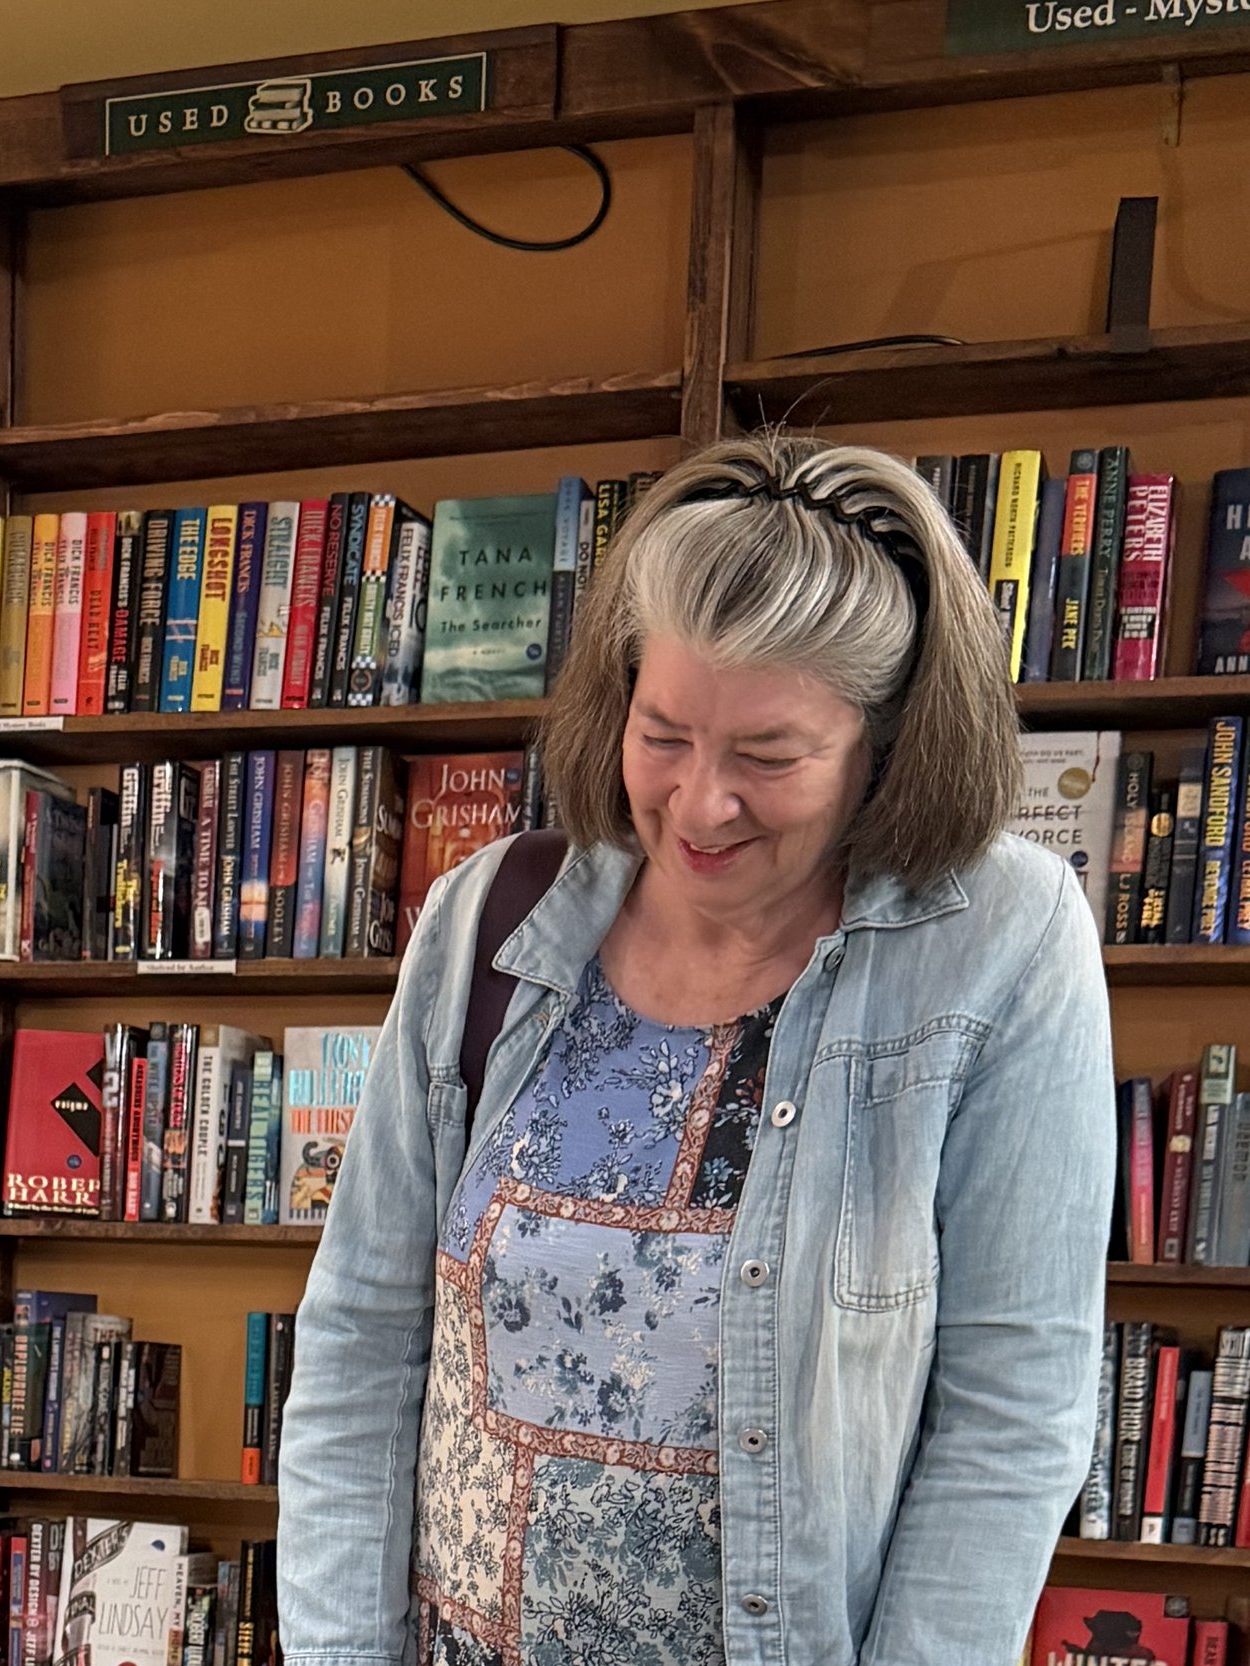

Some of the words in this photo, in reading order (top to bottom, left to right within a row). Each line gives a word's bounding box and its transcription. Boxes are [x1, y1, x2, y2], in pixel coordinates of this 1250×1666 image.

[1025, 1, 1116, 33] Used
[128, 104, 229, 137] USED
[325, 76, 464, 114] BOOKS
[179, 518, 200, 543] THE
[301, 509, 325, 542] DICK
[329, 503, 343, 530] NO
[1100, 505, 1116, 560] PERRY
[1124, 486, 1148, 562] PETERS
[1143, 485, 1168, 562] ELIZABETH
[143, 519, 169, 578] DRIVING
[177, 546, 198, 581] EDGE
[205, 517, 233, 602] LONGSHOT
[265, 516, 292, 588] STRAIGHT
[322, 532, 341, 597] RESERVE
[344, 503, 365, 587] SYNDICATE
[400, 528, 415, 562] FELIX
[459, 546, 533, 566] TANA
[140, 582, 163, 627] FORCE
[392, 565, 412, 621] FRANCIS
[440, 580, 548, 602] FRENCH
[112, 609, 130, 663] DAMAGE
[440, 619, 466, 633] The
[472, 616, 542, 633] Searcher
[1213, 720, 1236, 764] JOHN
[252, 756, 266, 790] JOHN
[435, 764, 506, 800] JOHN
[1027, 787, 1049, 798] THE
[250, 793, 264, 850] GRISHAM
[411, 800, 521, 829] GRISHAM
[1205, 766, 1233, 847] SANDFORD
[272, 888, 286, 945] SOOLEY
[1122, 1357, 1146, 1399] BRAD
[1119, 1401, 1144, 1441] THOR
[129, 1565, 168, 1600] JEFF
[98, 1601, 169, 1640] LINDSAY
